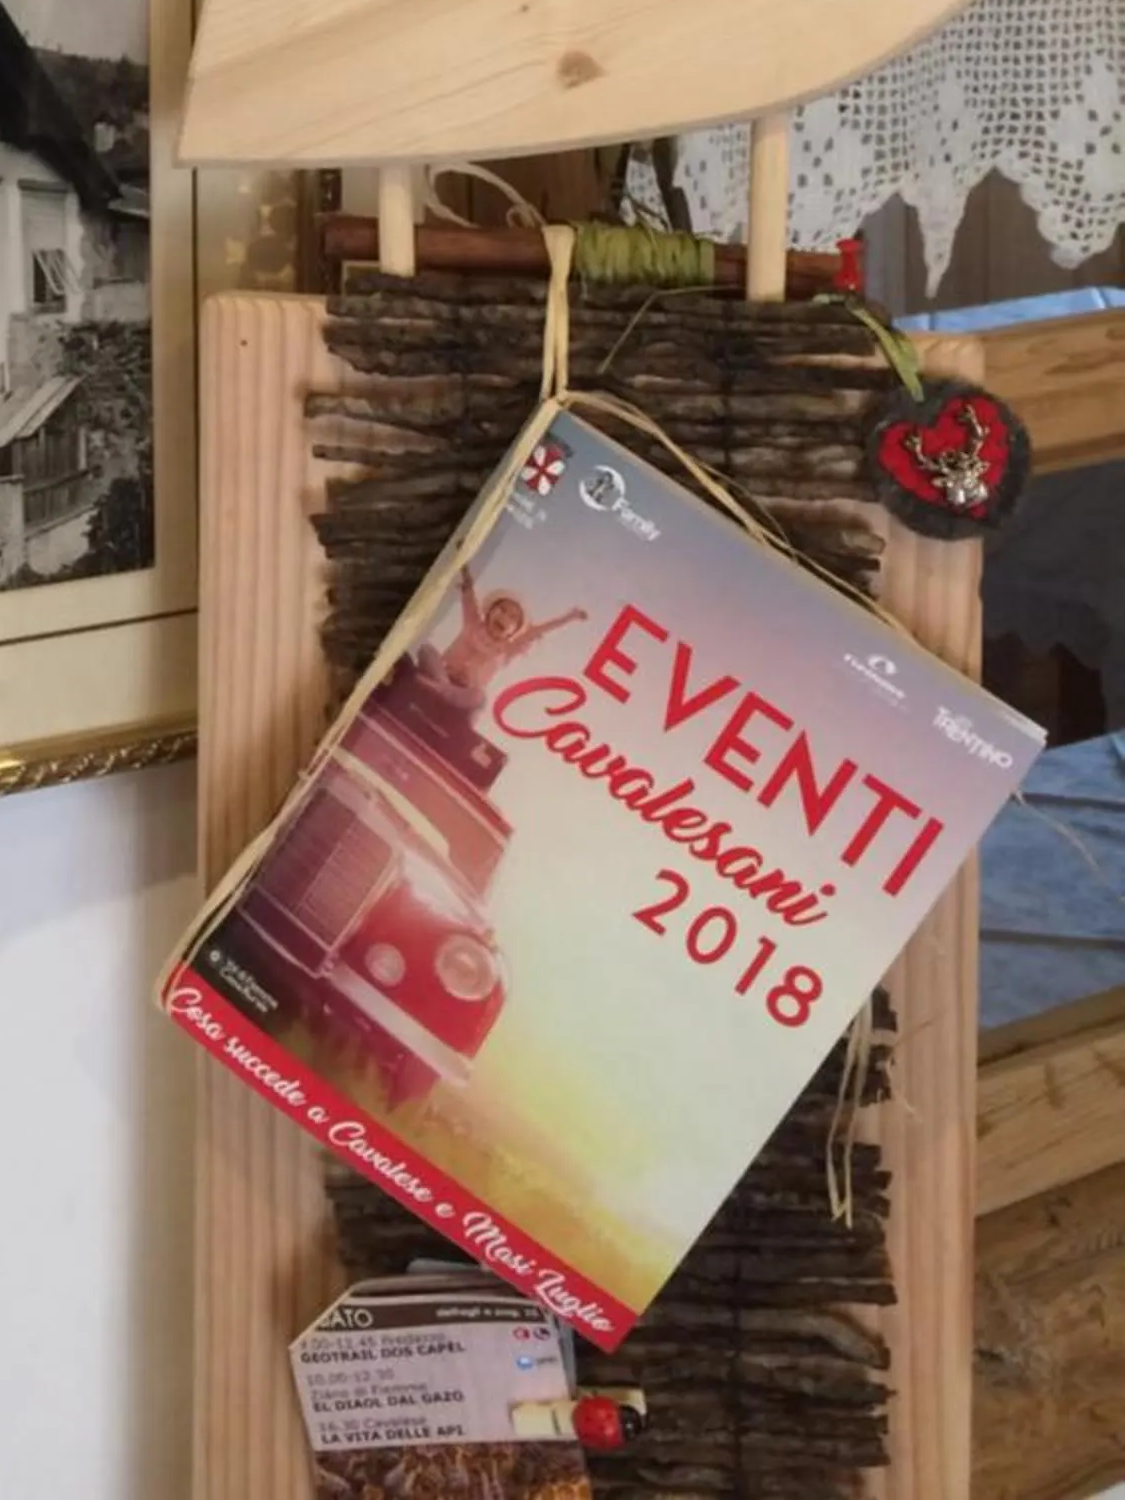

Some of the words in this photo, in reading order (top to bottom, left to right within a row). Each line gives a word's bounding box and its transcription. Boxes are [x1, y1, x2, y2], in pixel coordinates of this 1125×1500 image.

[611, 497, 662, 541] Family
[582, 604, 945, 898] EVENTI
[492, 677, 836, 927] Cavalesani
[632, 869, 824, 1028] 2018
[170, 987, 224, 1041] Cosa
[223, 1036, 306, 1107] succede
[307, 1105, 329, 1125] a
[328, 1120, 434, 1206] Cavalese
[435, 1201, 456, 1219] e
[463, 1211, 537, 1278] Masi
[536, 1268, 615, 1334] Luglio
[301, 1350, 376, 1363] GEOTRAIL
[381, 1346, 413, 1358] DOS
[416, 1341, 466, 1356] CAPEL
[313, 1400, 332, 1412] EL
[321, 1432, 342, 1444] LA
[345, 1430, 381, 1443] VITA
[385, 1426, 430, 1439] DELLE
[436, 1424, 466, 1437] API
